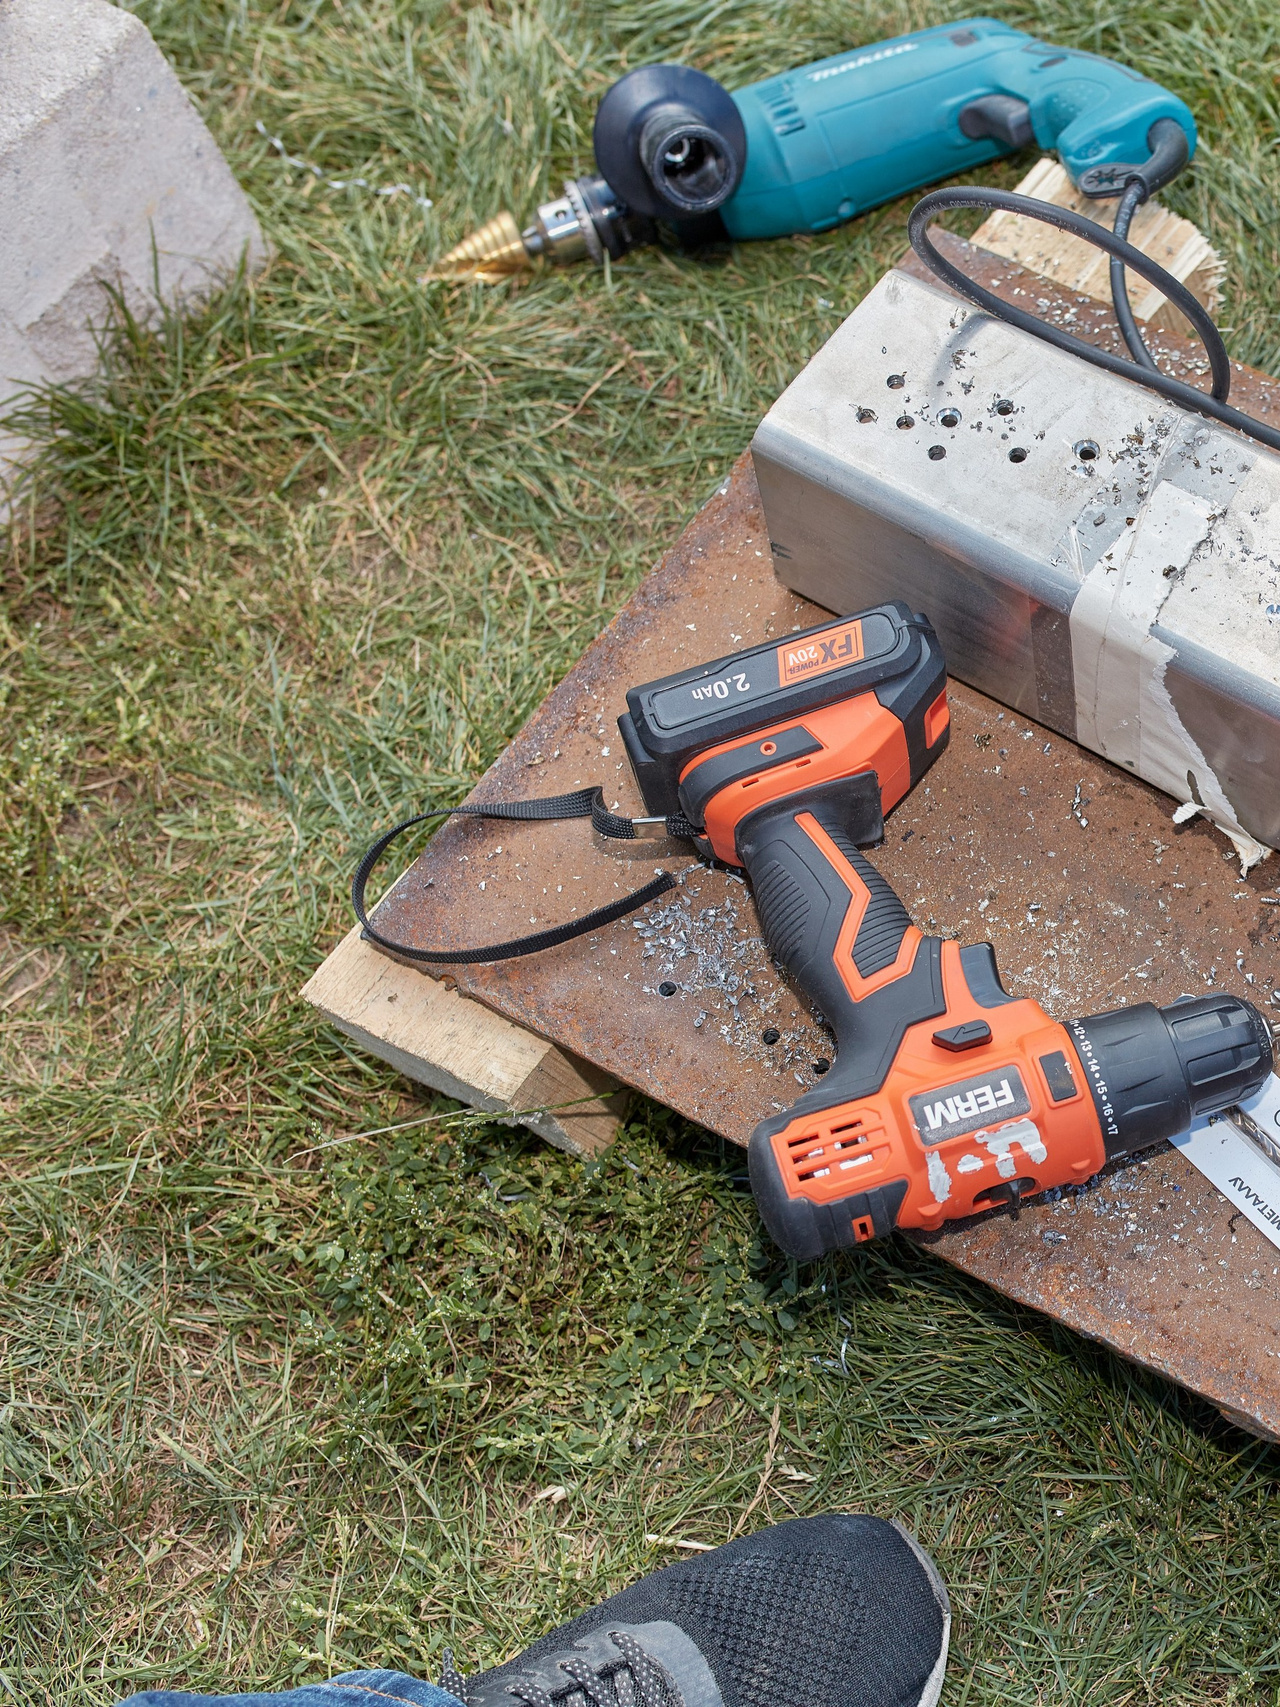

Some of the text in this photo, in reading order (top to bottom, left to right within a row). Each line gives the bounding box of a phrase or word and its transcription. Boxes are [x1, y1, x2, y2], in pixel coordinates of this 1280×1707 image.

[788, 645, 818, 666] 20V
[789, 633, 853, 675] FX POWER
[691, 672, 750, 701] 2.0Ah
[1073, 1026, 1086, 1036] 12
[1080, 1040, 1093, 1052] 13
[1087, 1058, 1100, 1072] 14
[1095, 1080, 1108, 1094] 15
[923, 1079, 1015, 1130] FERM
[1102, 1102, 1114, 1116] 16
[1107, 1123, 1119, 1135] 17
